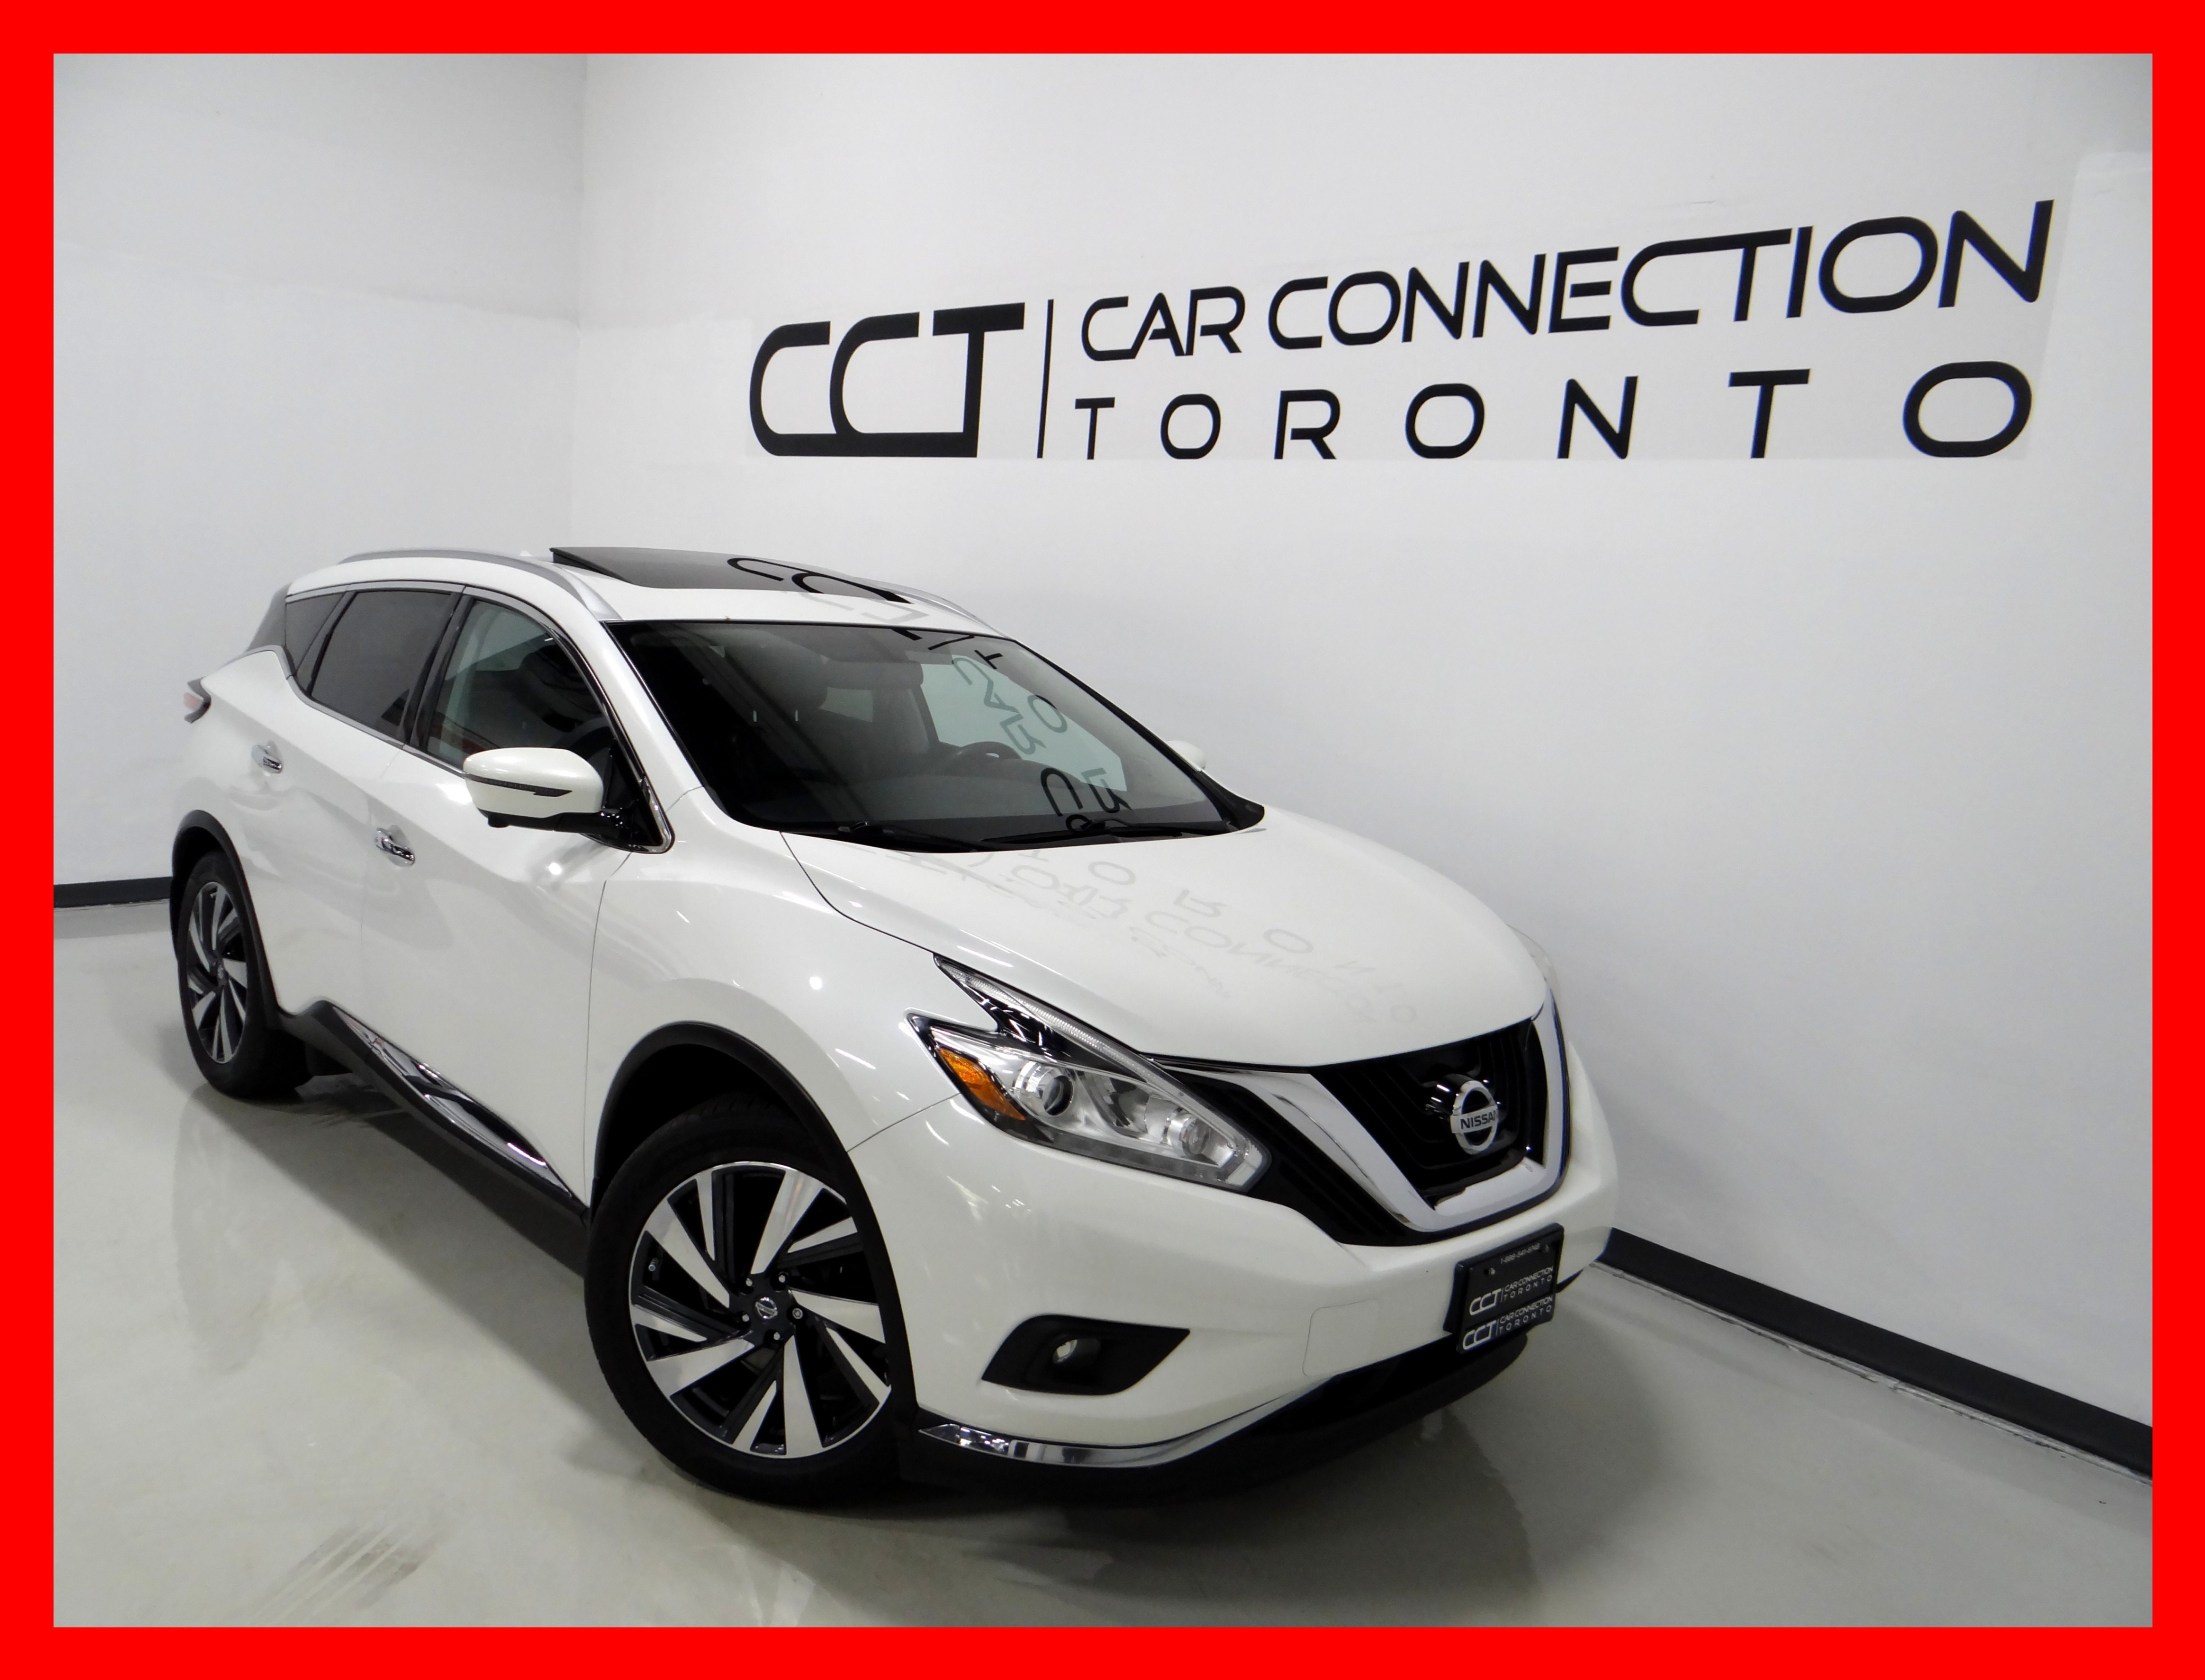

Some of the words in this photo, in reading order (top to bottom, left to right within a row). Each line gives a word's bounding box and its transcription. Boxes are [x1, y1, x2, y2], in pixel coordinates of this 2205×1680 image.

[1082, 286, 1246, 361] CAR
[1268, 199, 2054, 350] CONNECTION
[750, 302, 1025, 458] CCT
[1075, 361, 2032, 460] TORONTO
[1504, 1282, 1518, 1292] CAR
[1518, 1266, 1554, 1287] CONNECTION
[1504, 1275, 1552, 1300] TORONTO
[1469, 1288, 1502, 1316] CCT
[1500, 1314, 1514, 1324] CAR
[1514, 1295, 1553, 1318] CONNECTION
[1498, 1305, 1552, 1334] TORONTO
[1462, 1320, 1497, 1350] CCT
